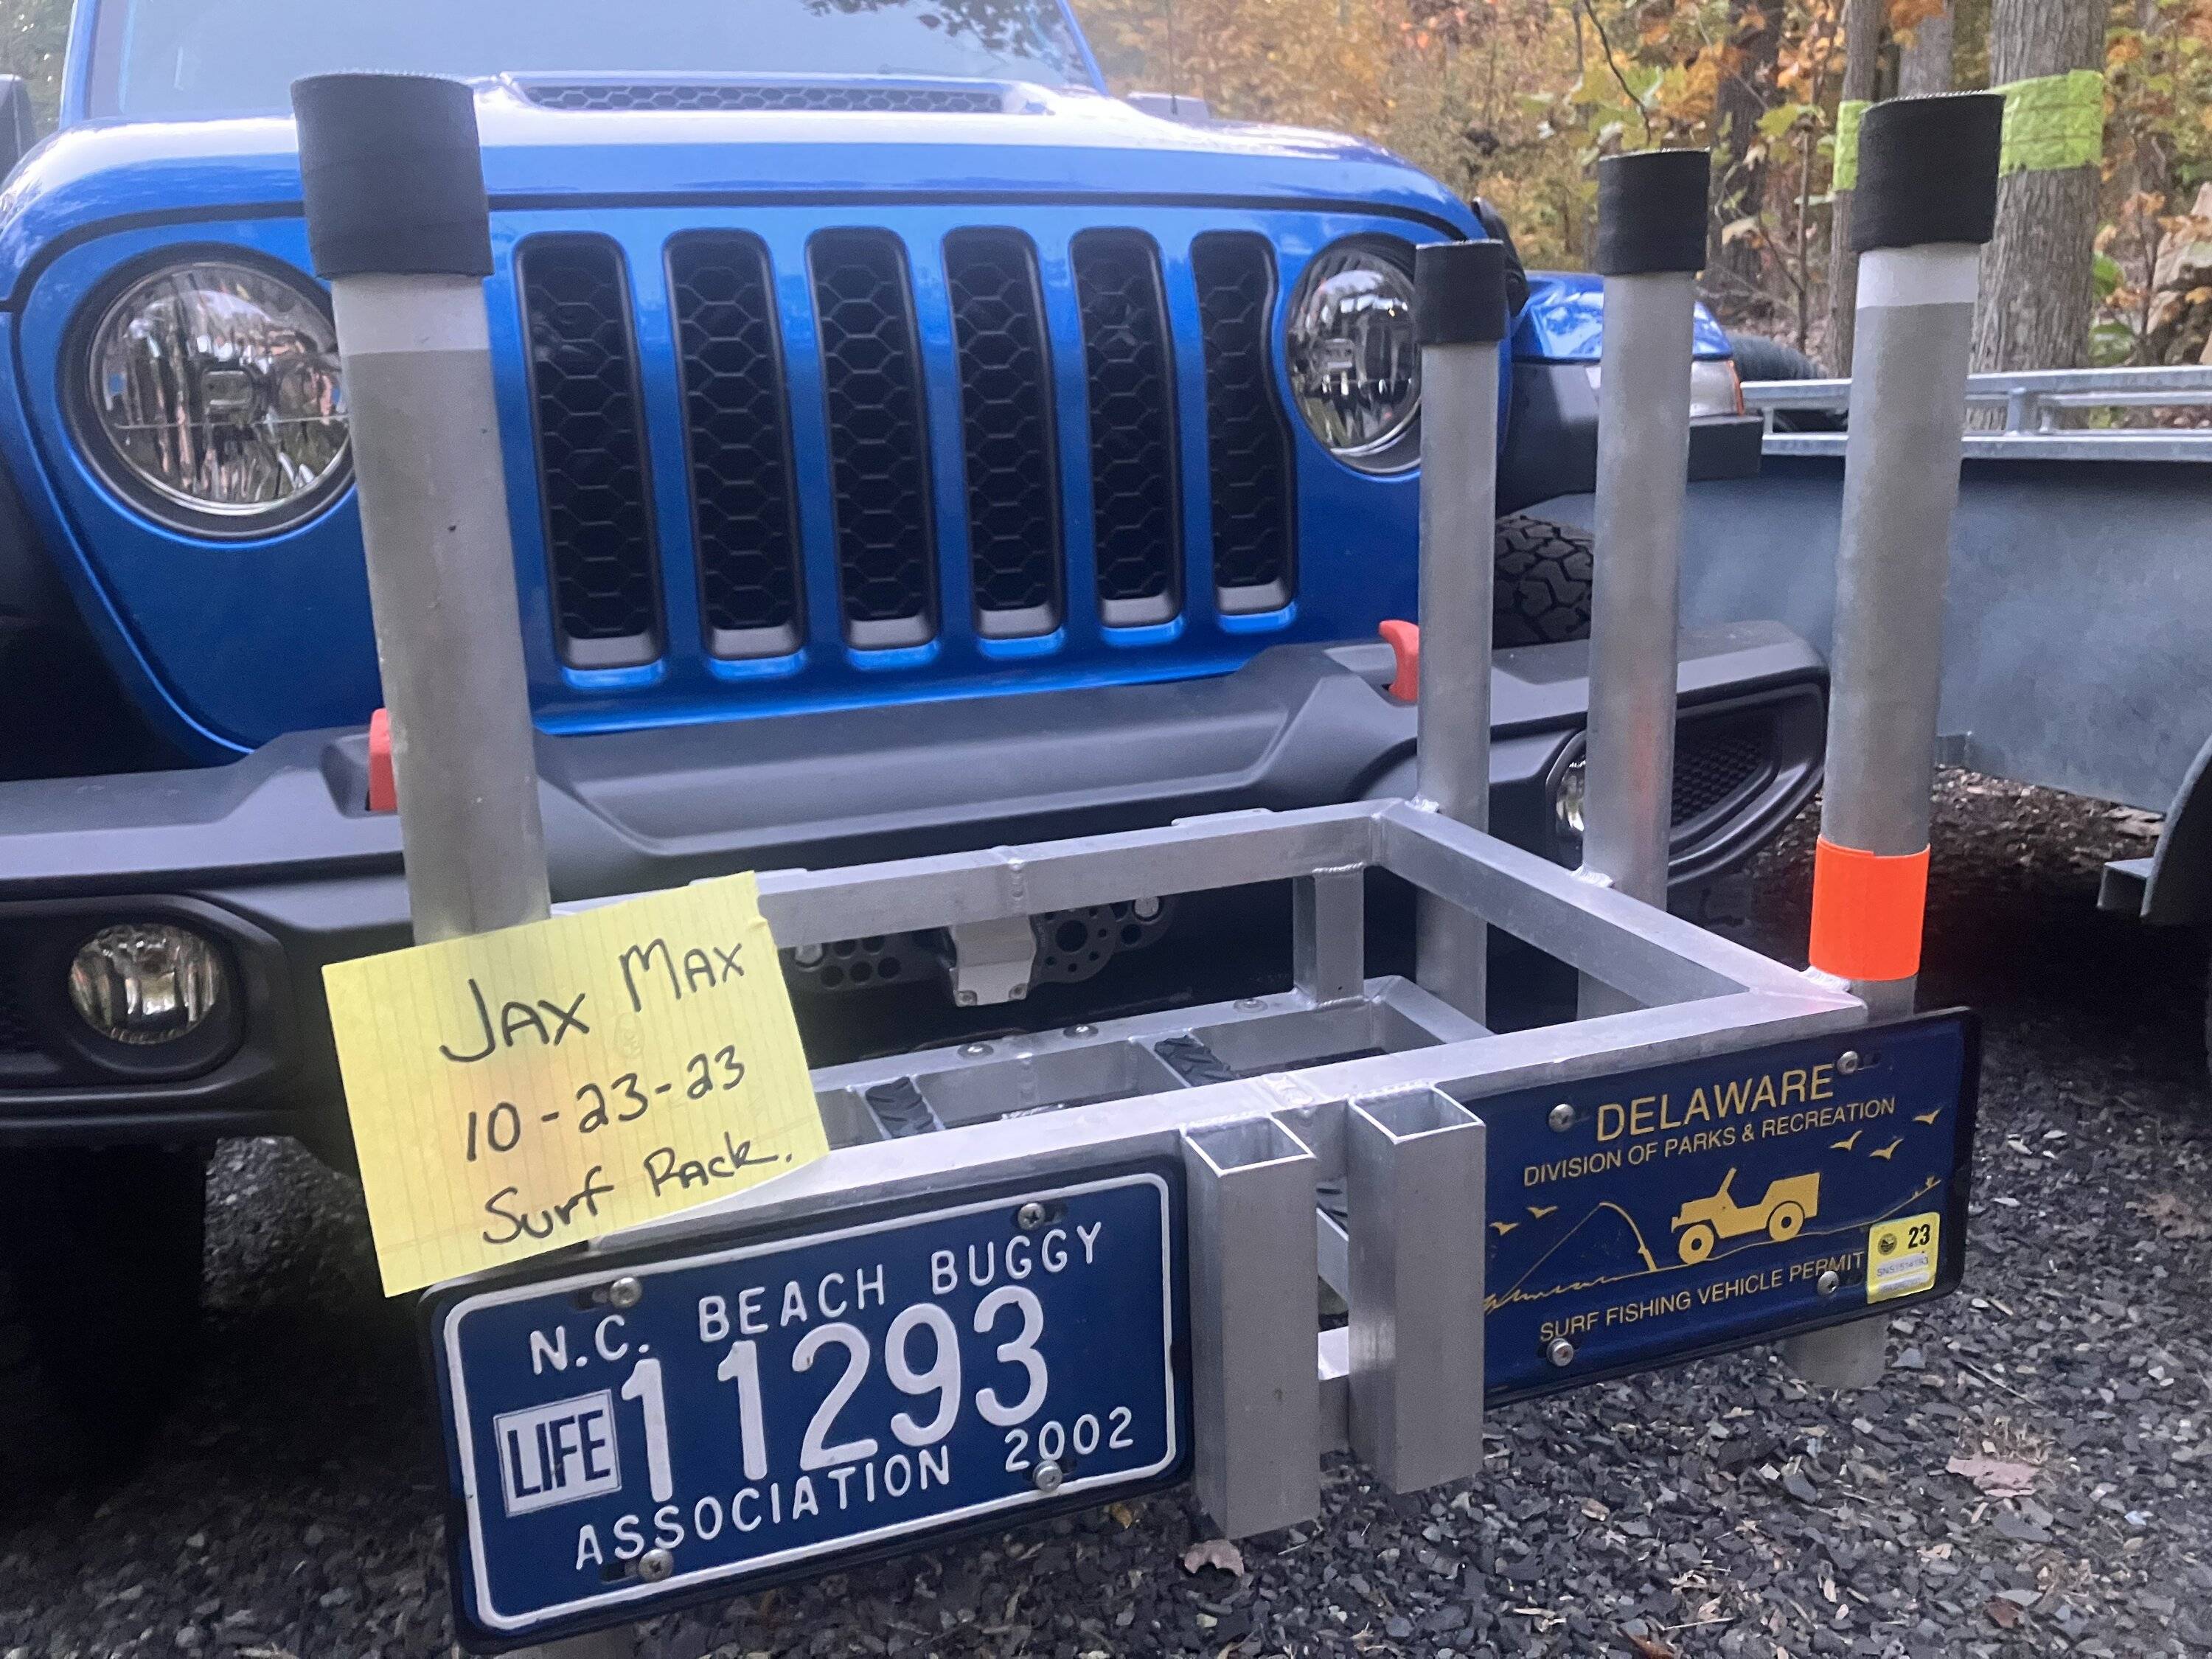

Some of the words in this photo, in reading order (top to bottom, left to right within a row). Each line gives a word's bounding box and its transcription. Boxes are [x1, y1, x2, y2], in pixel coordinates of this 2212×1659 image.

[465, 1044, 745, 1161] 10-23-23
[1523, 1150, 1621, 1186] DIVISION
[1627, 1142, 1658, 1165] OF
[1664, 1127, 1736, 1158] PARKS
[1741, 1124, 1755, 1142] &
[1761, 1096, 1896, 1138] RECREATION
[1596, 1062, 1834, 1142] DELAWARE
[482, 1165, 613, 1244] Surf
[1907, 1223, 1931, 1249] 23
[529, 1315, 650, 1374] N.C.
[698, 1263, 885, 1342] BEACH
[931, 1222, 1102, 1295] BUGGY
[1540, 1311, 1600, 1343] SURF
[1606, 1291, 1691, 1326] FISHING
[1697, 1269, 1783, 1304] VEHICLE
[1790, 1251, 1865, 1282] PERMIT
[620, 1285, 1048, 1503] 11293
[507, 1409, 611, 1498] LIFE
[575, 1444, 950, 1570] ASSOCIATION
[1004, 1406, 1134, 1472] 2002
